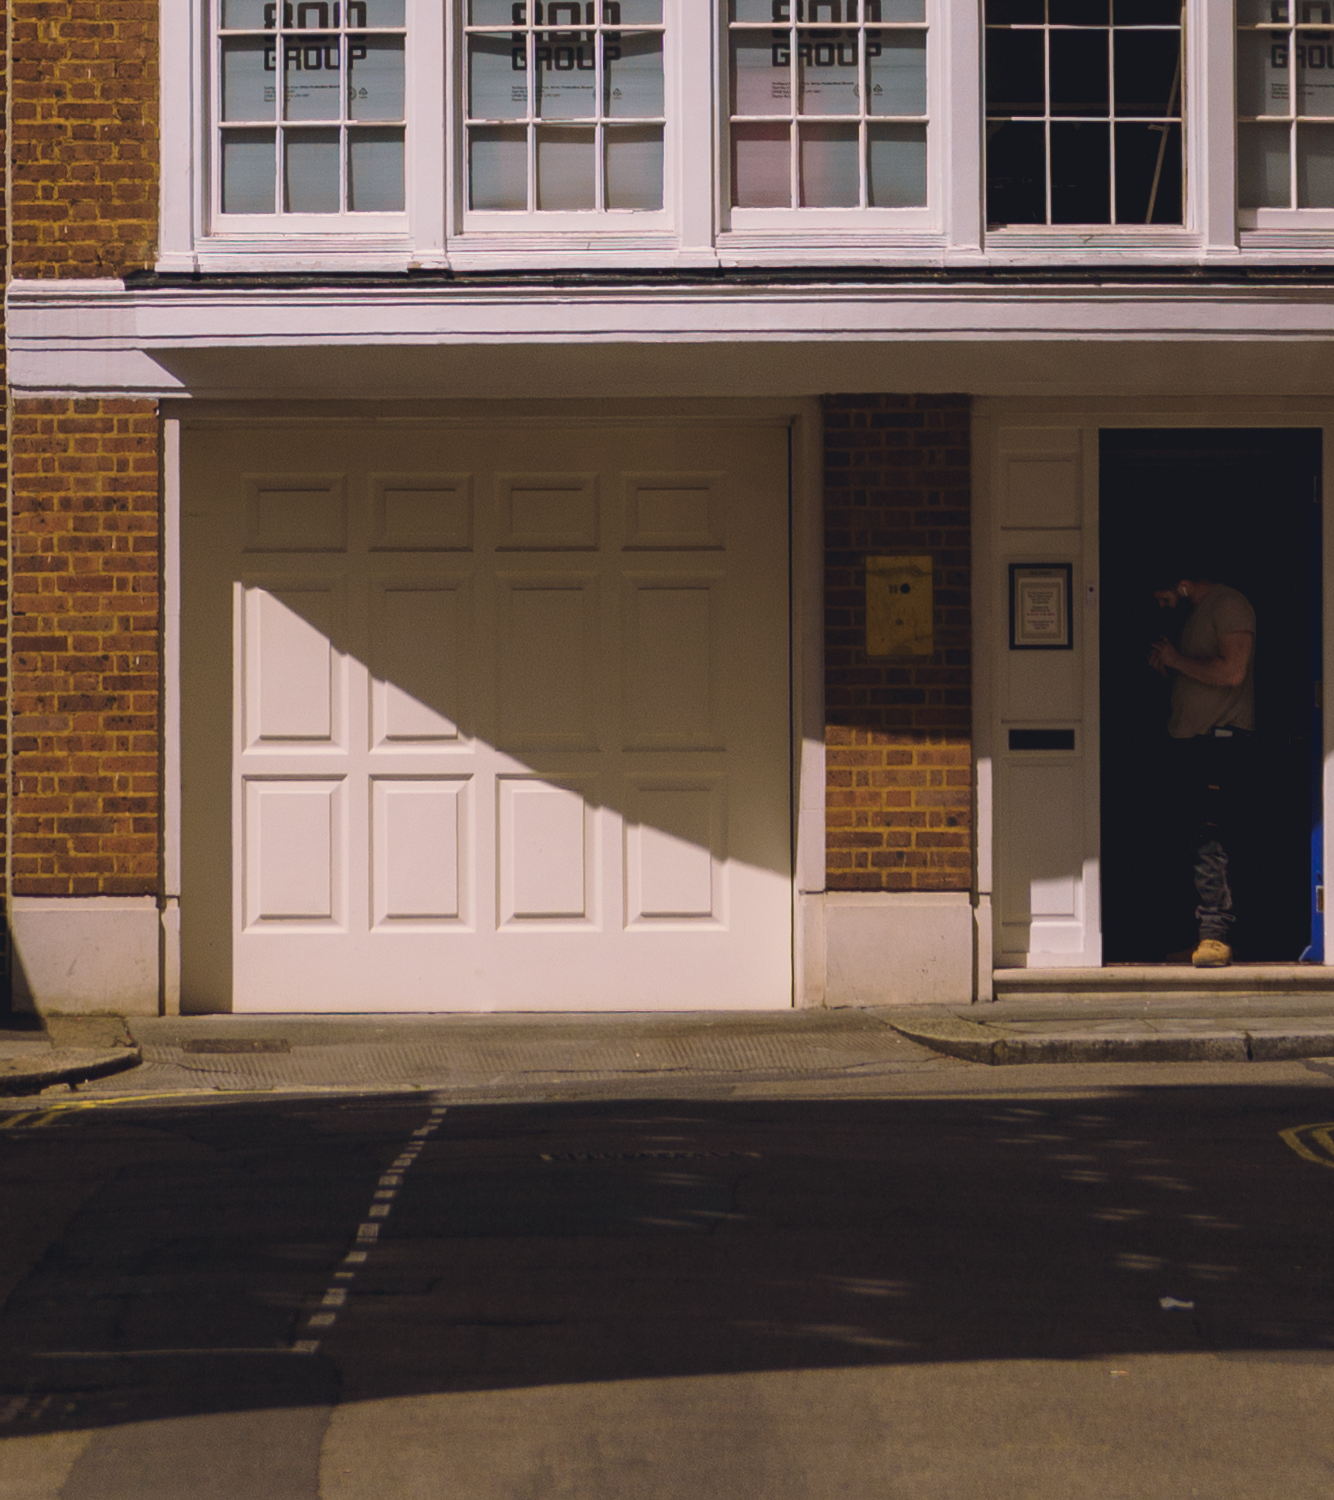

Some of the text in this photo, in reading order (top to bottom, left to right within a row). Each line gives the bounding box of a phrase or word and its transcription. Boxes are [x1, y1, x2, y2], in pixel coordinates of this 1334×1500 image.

[264, 46, 367, 71] GROUP
[512, 46, 621, 71] GROUP
[772, 42, 882, 67] GROUP
